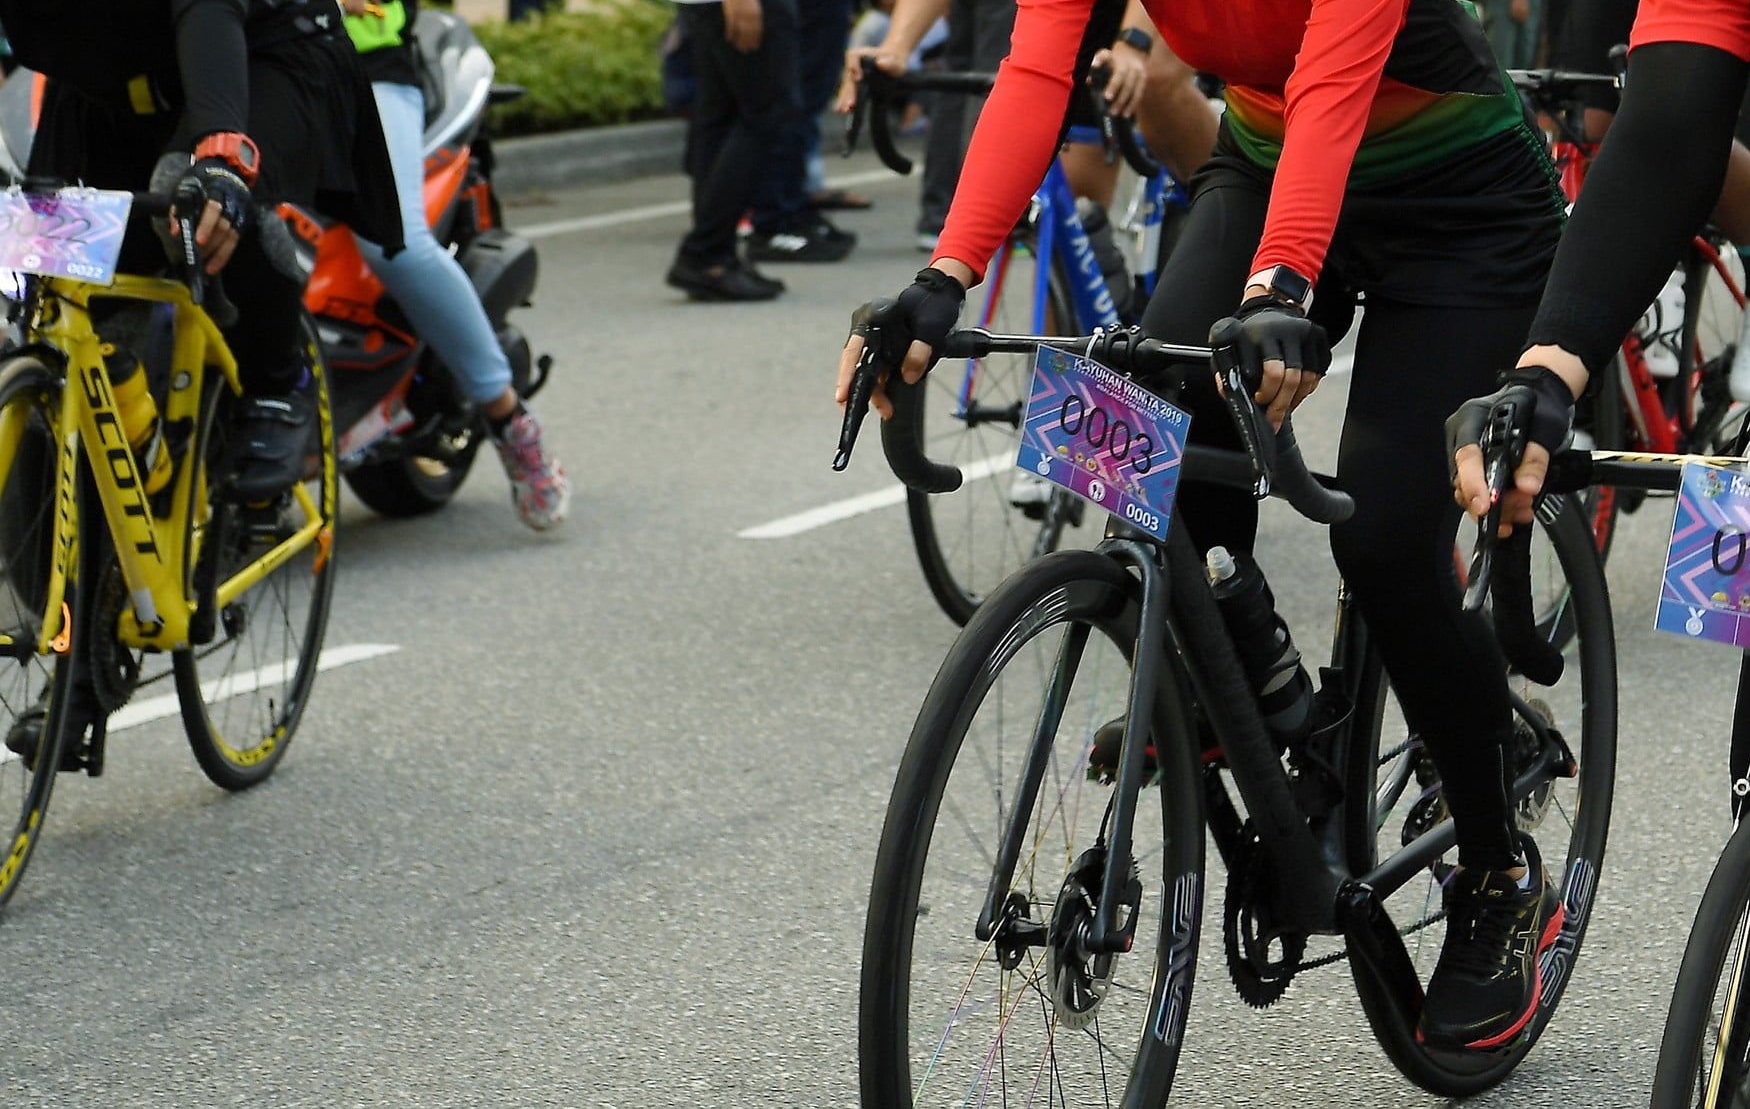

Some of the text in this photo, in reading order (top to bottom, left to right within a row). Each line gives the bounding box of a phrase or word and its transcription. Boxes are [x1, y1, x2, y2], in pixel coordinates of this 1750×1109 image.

[1123, 381, 1159, 410] WANITA
[1159, 404, 1183, 423] 2019
[80, 366, 162, 564] SCOTT
[1060, 394, 1153, 475] 0003
[1125, 502, 1159, 532] 0003
